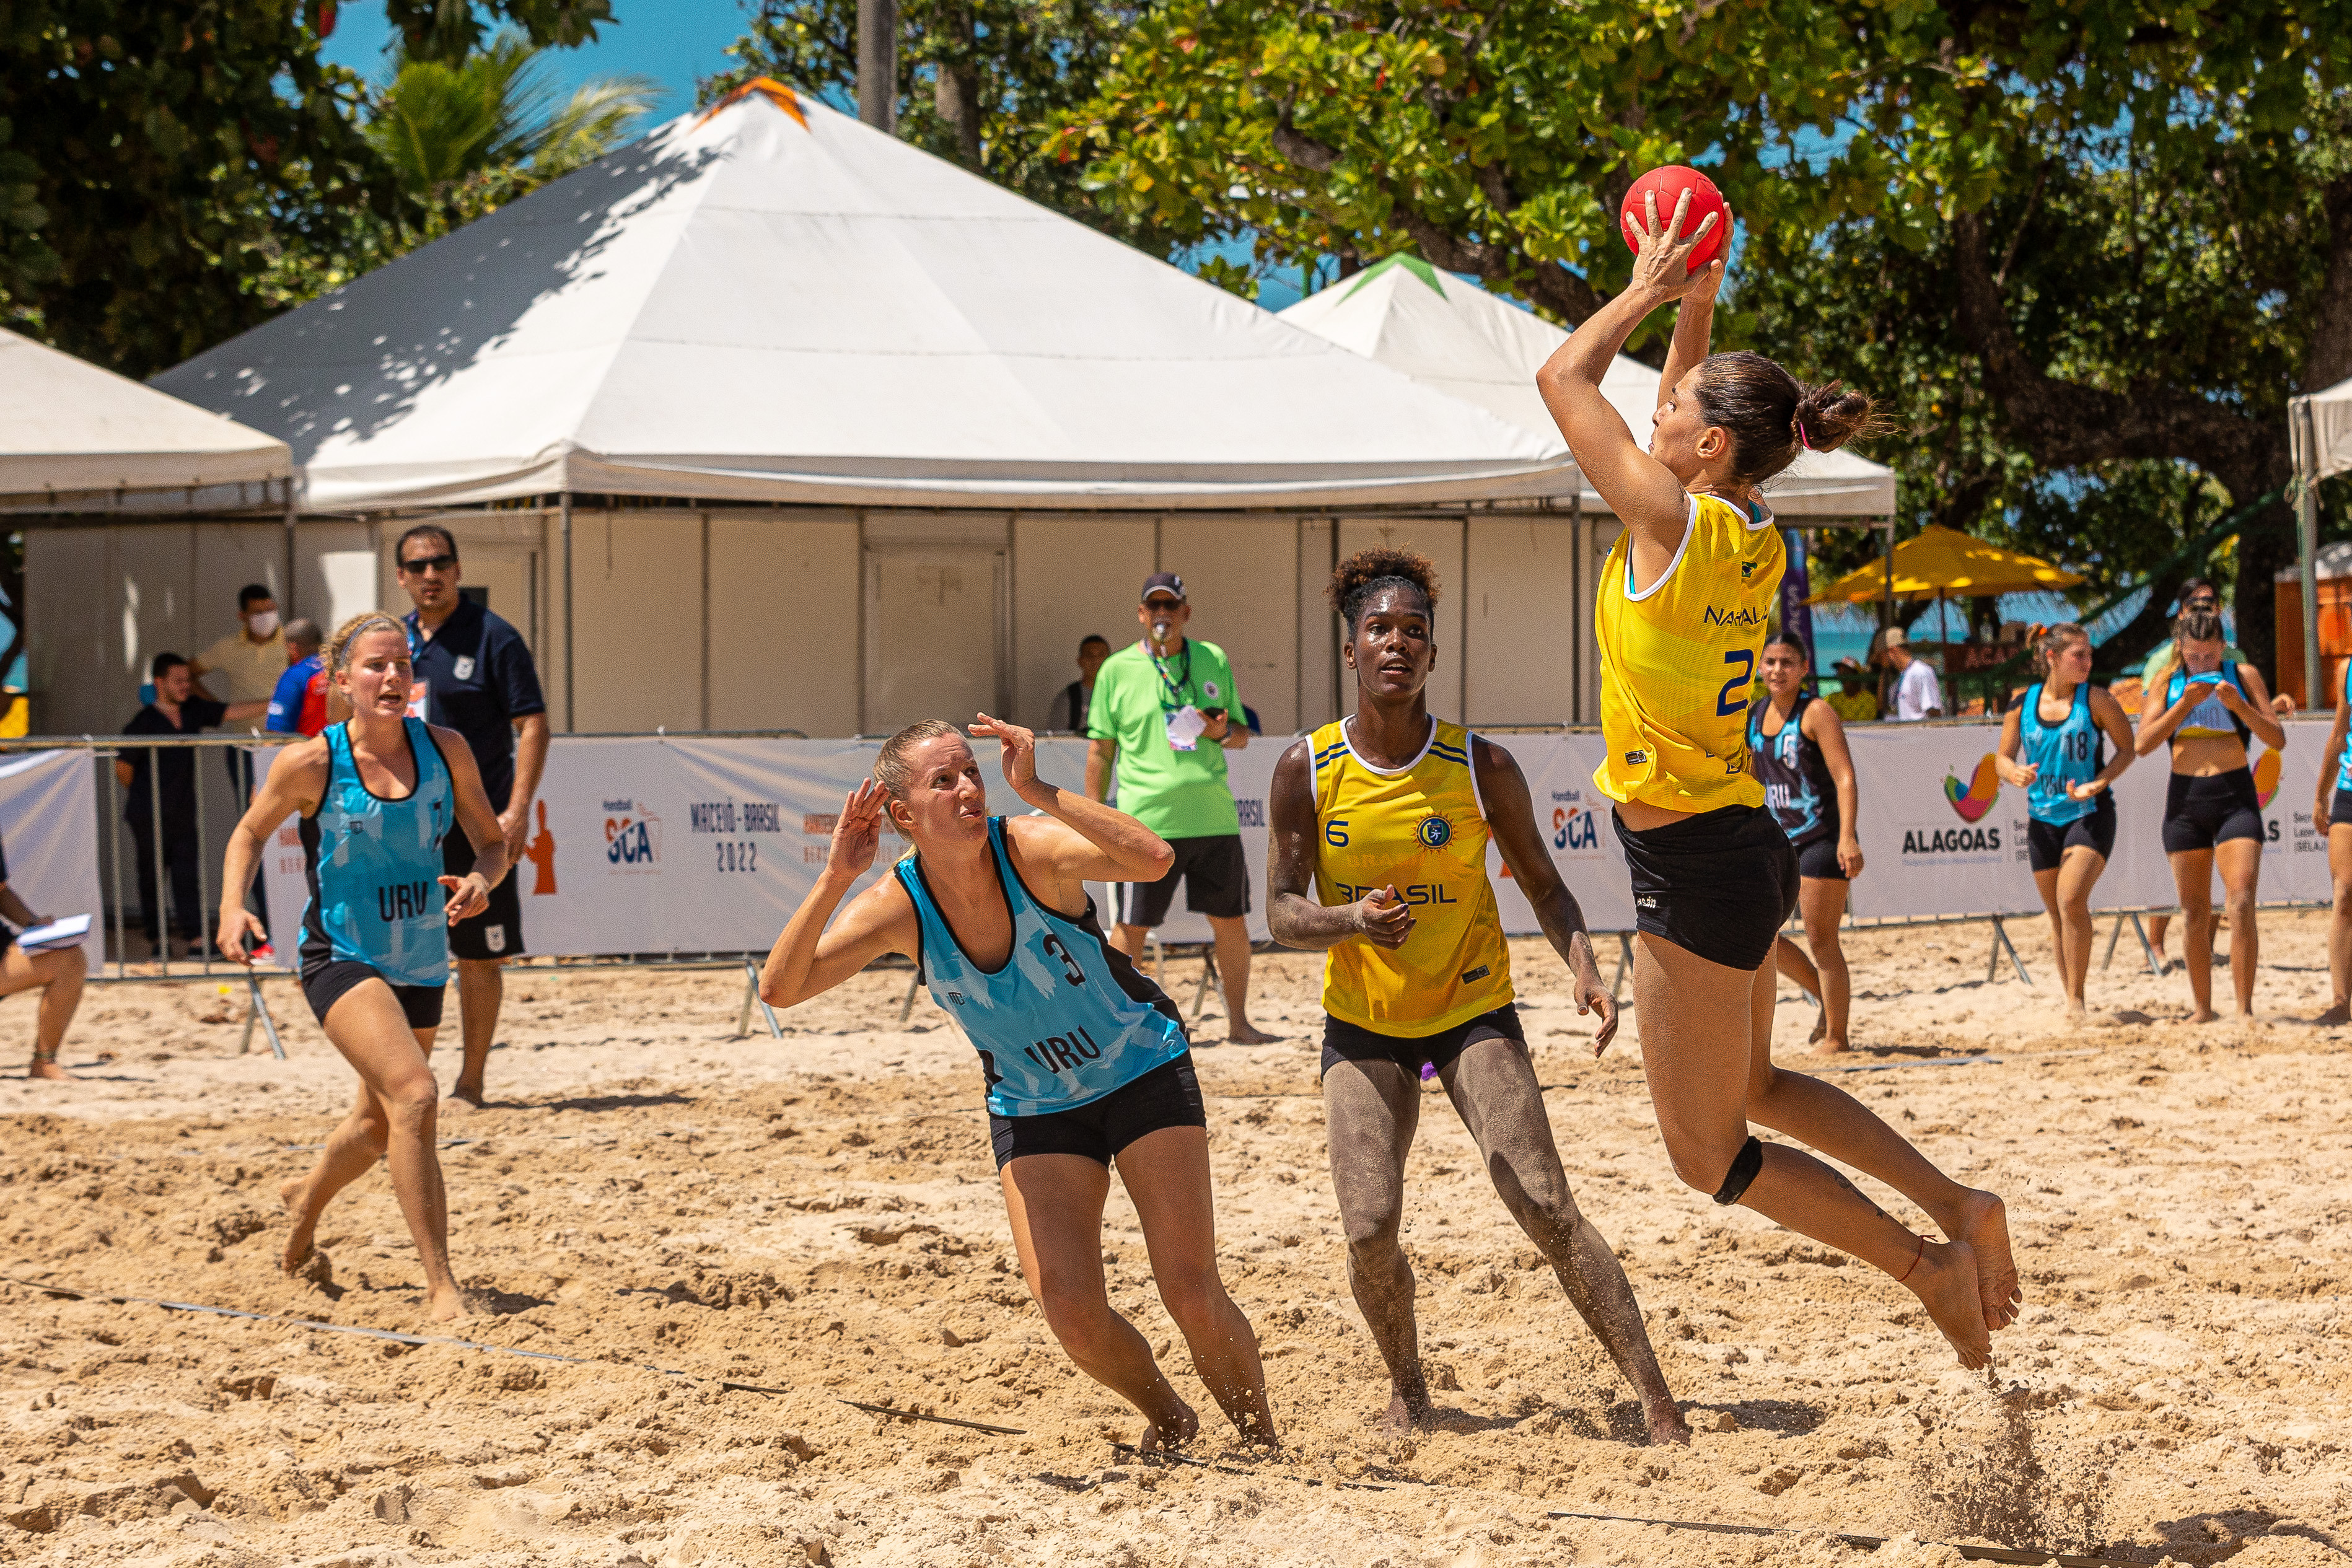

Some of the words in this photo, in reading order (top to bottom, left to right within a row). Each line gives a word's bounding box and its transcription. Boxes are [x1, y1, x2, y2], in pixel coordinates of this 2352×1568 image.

[1716, 649, 1754, 717] 2
[1783, 735, 1797, 769] 5
[2066, 731, 2088, 761] 18
[1237, 797, 1265, 826] RASIL
[1552, 807, 1598, 849] SCA
[604, 818, 654, 863] SCA
[1325, 820, 1349, 848] 6
[1902, 828, 2001, 854] ALAGOAS
[716, 841, 757, 872] 2022
[1043, 934, 1086, 987] 3
[1024, 1024, 1100, 1075] URU
